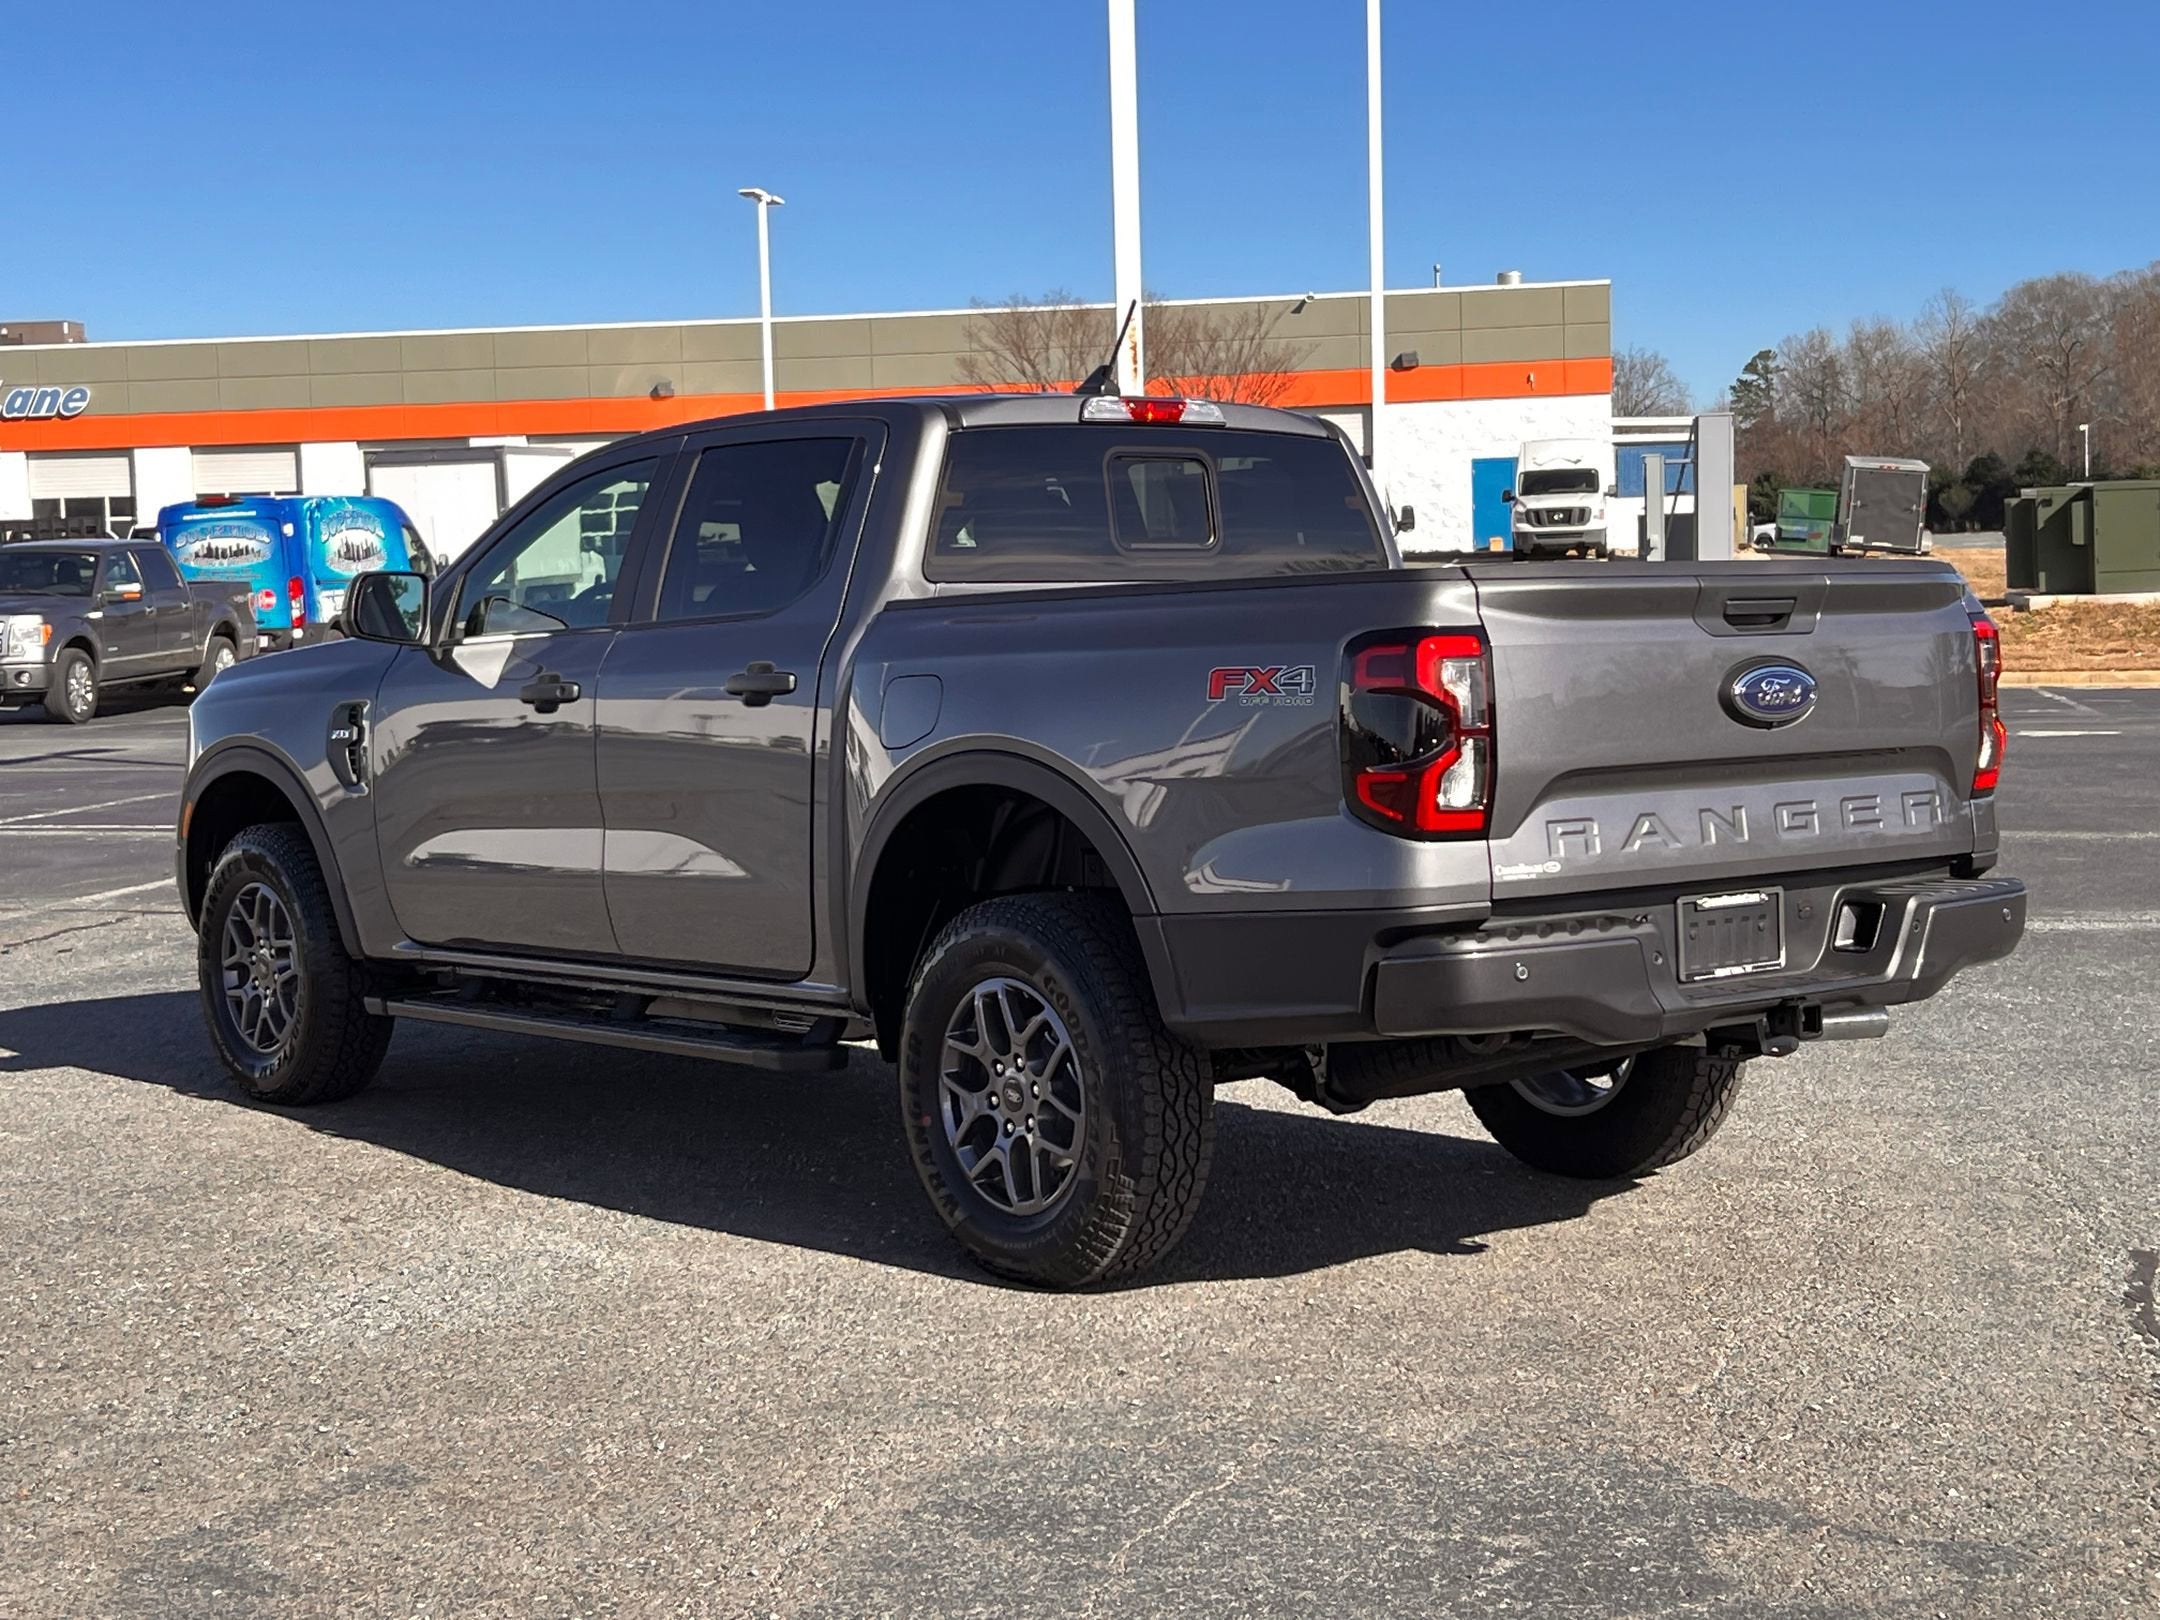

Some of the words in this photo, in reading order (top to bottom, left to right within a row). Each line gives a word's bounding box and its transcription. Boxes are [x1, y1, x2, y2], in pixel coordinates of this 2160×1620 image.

[0, 385, 91, 419] ane
[1207, 665, 1316, 702] FX4
[1758, 677, 1802, 706] Ford
[1545, 789, 1943, 859] RANGER
